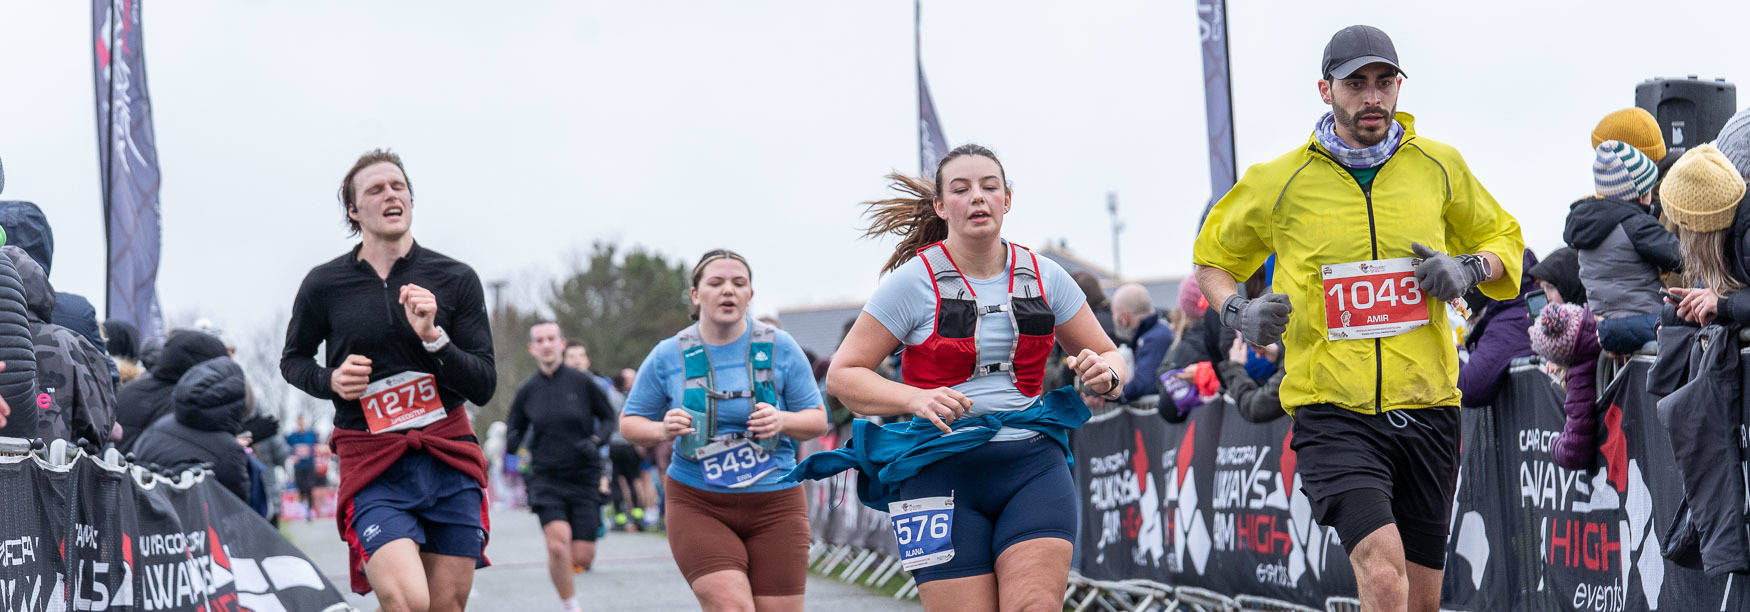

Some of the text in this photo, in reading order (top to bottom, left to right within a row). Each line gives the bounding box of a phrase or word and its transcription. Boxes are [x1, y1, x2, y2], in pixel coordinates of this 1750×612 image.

[1328, 276, 1422, 312] 1043
[1366, 314, 1389, 324] AMIR
[367, 378, 436, 419] 1275
[905, 547, 924, 558] ALANA
[1550, 517, 1622, 572] HIGH
[1573, 577, 1624, 612] events
